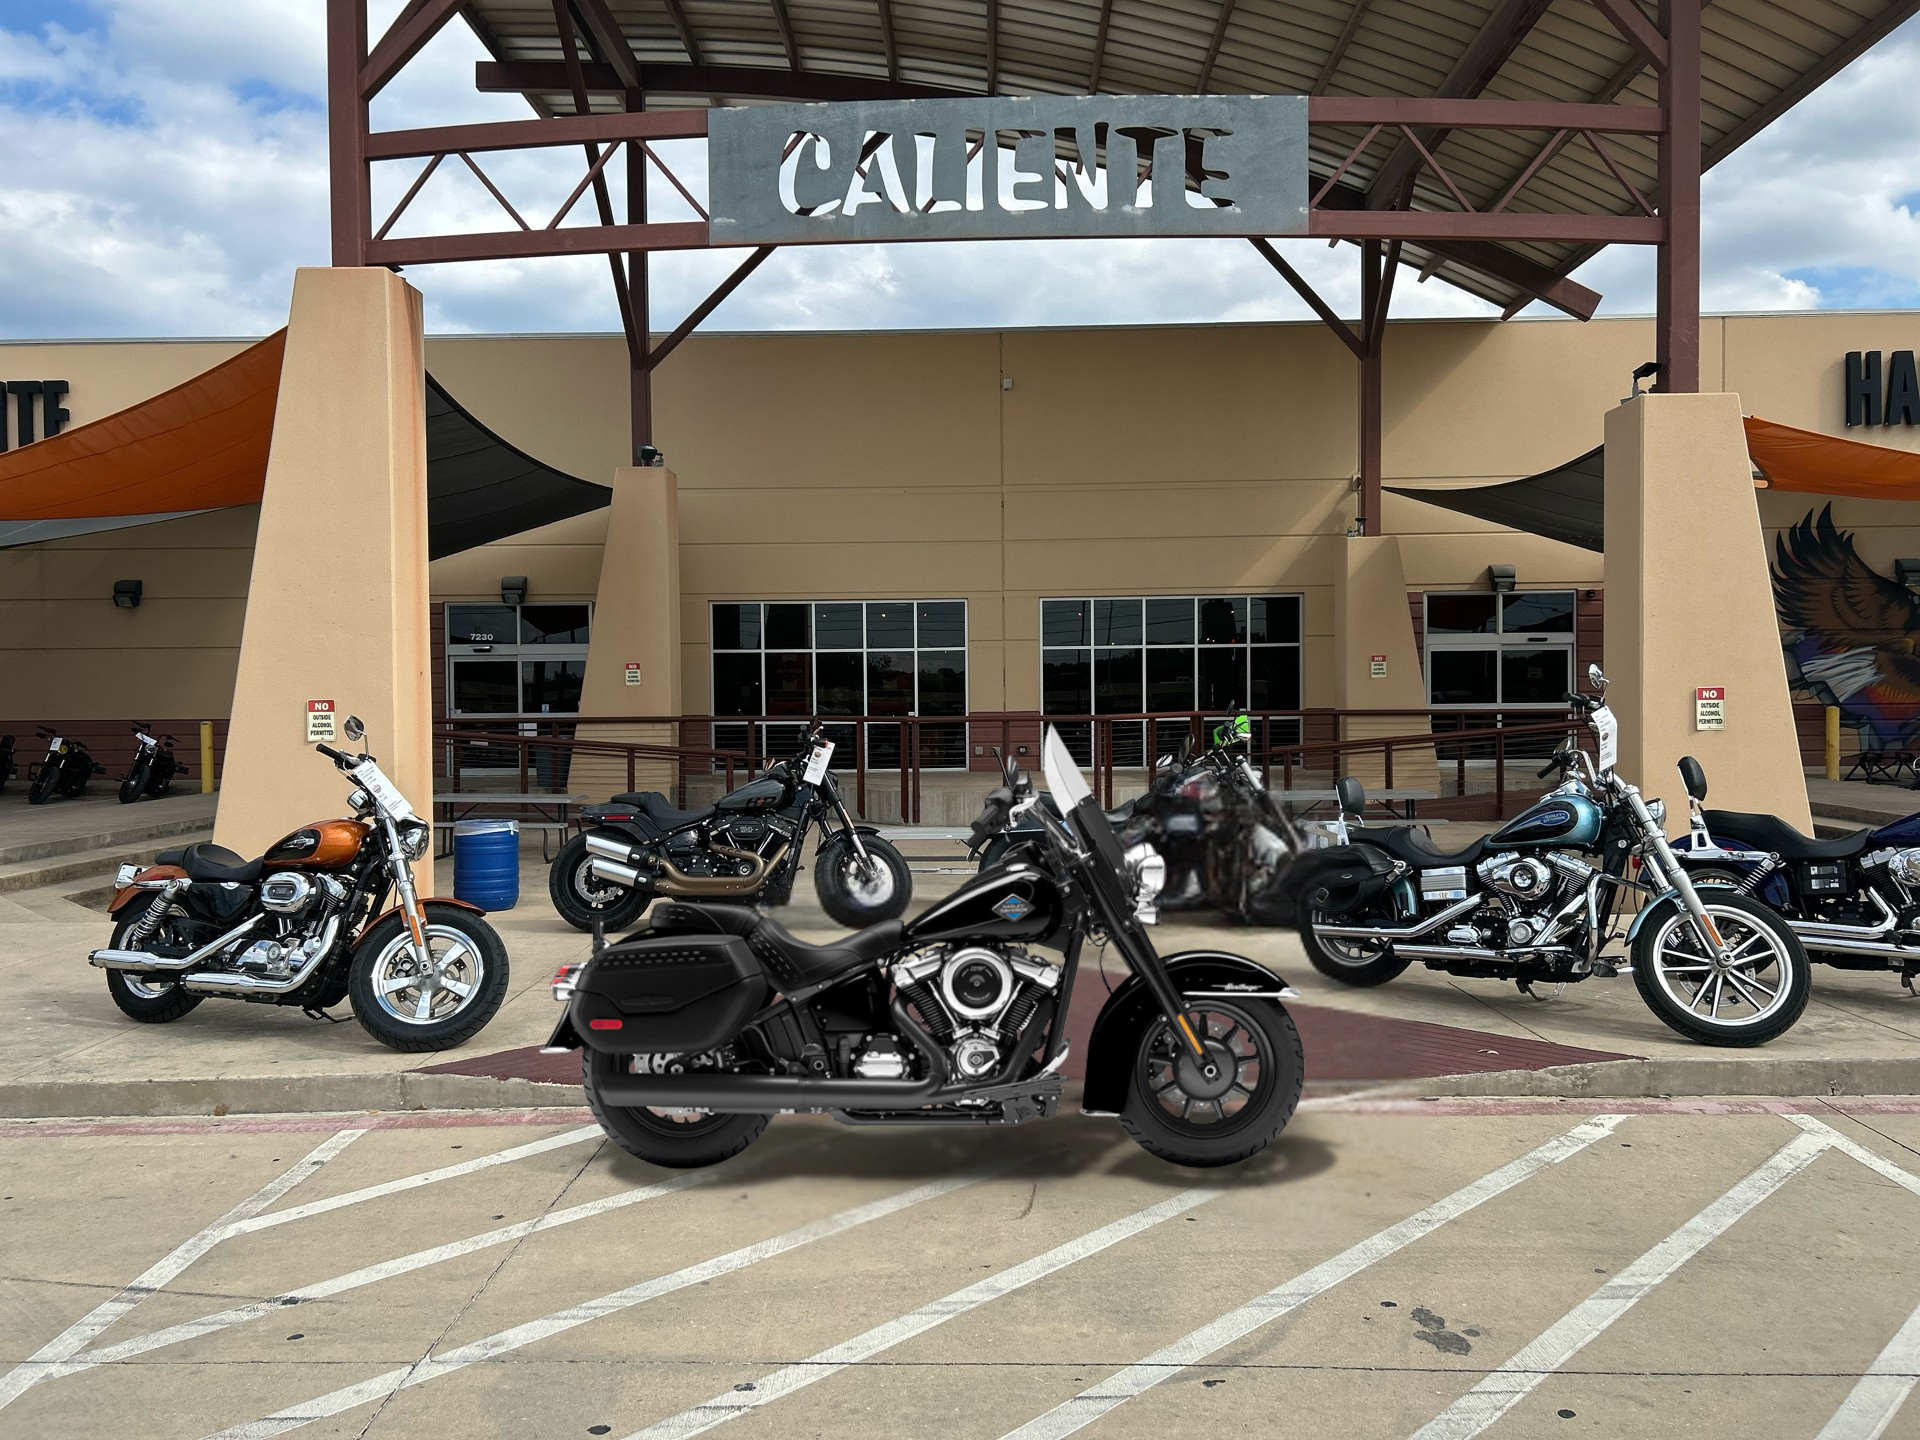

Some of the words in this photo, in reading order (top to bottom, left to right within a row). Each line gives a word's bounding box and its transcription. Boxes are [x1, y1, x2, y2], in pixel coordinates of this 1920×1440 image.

[778, 121, 1236, 217] CALIENTE
[470, 633, 494, 641] 7230
[1702, 690, 1718, 699] NO
[314, 702, 329, 711] NO
